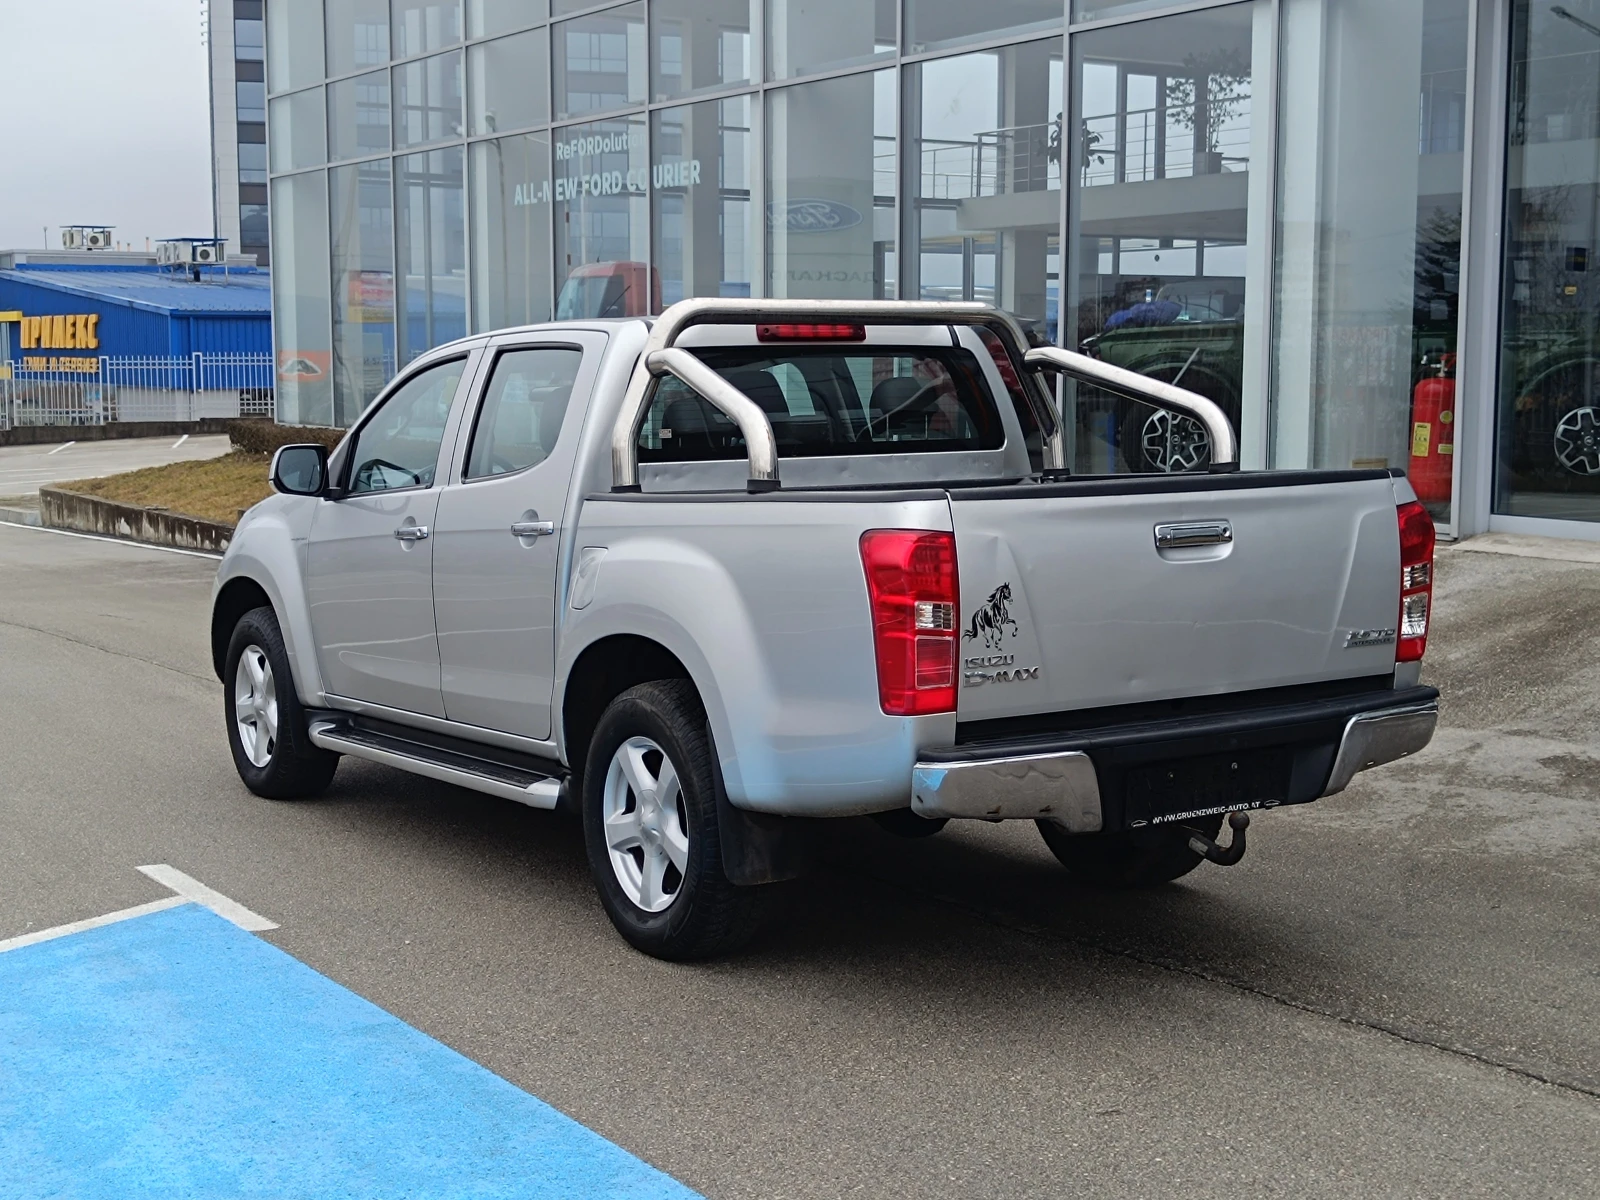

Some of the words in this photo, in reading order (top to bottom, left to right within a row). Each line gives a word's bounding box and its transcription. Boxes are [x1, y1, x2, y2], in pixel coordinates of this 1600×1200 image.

[514, 177, 578, 206] ALL-NEW
[581, 170, 622, 198] FORD
[626, 160, 701, 192] COURIER
[20, 314, 99, 350] ПРИМЕКС
[964, 654, 1015, 670] ISUZU
[963, 666, 1040, 688] D-MAX
